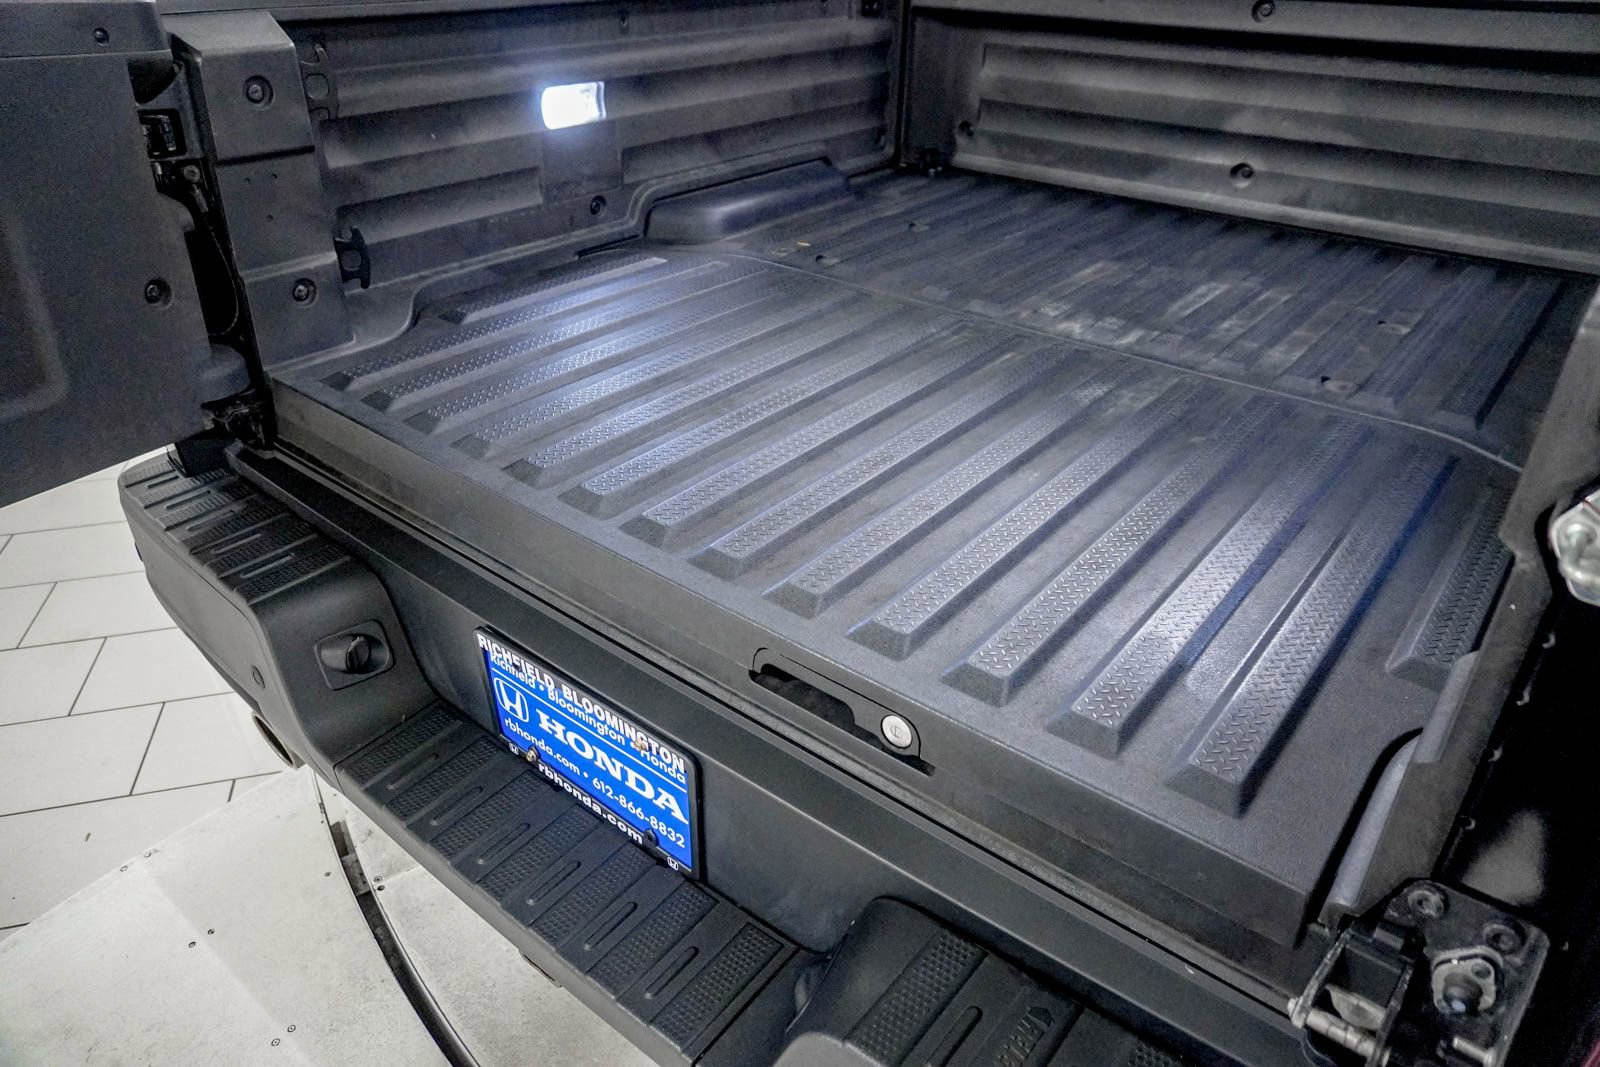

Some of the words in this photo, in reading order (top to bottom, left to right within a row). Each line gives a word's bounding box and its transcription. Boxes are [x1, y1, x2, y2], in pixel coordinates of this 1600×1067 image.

[477, 633, 555, 690] RICHFIELD
[562, 684, 686, 774] BLOOMINGTON
[547, 686, 626, 746] Bloomington
[505, 718, 581, 776] rbhonda.com
[592, 777, 687, 849] 612-866-8832
[536, 708, 689, 825] HONDA
[538, 763, 643, 846] rbhonda.com
